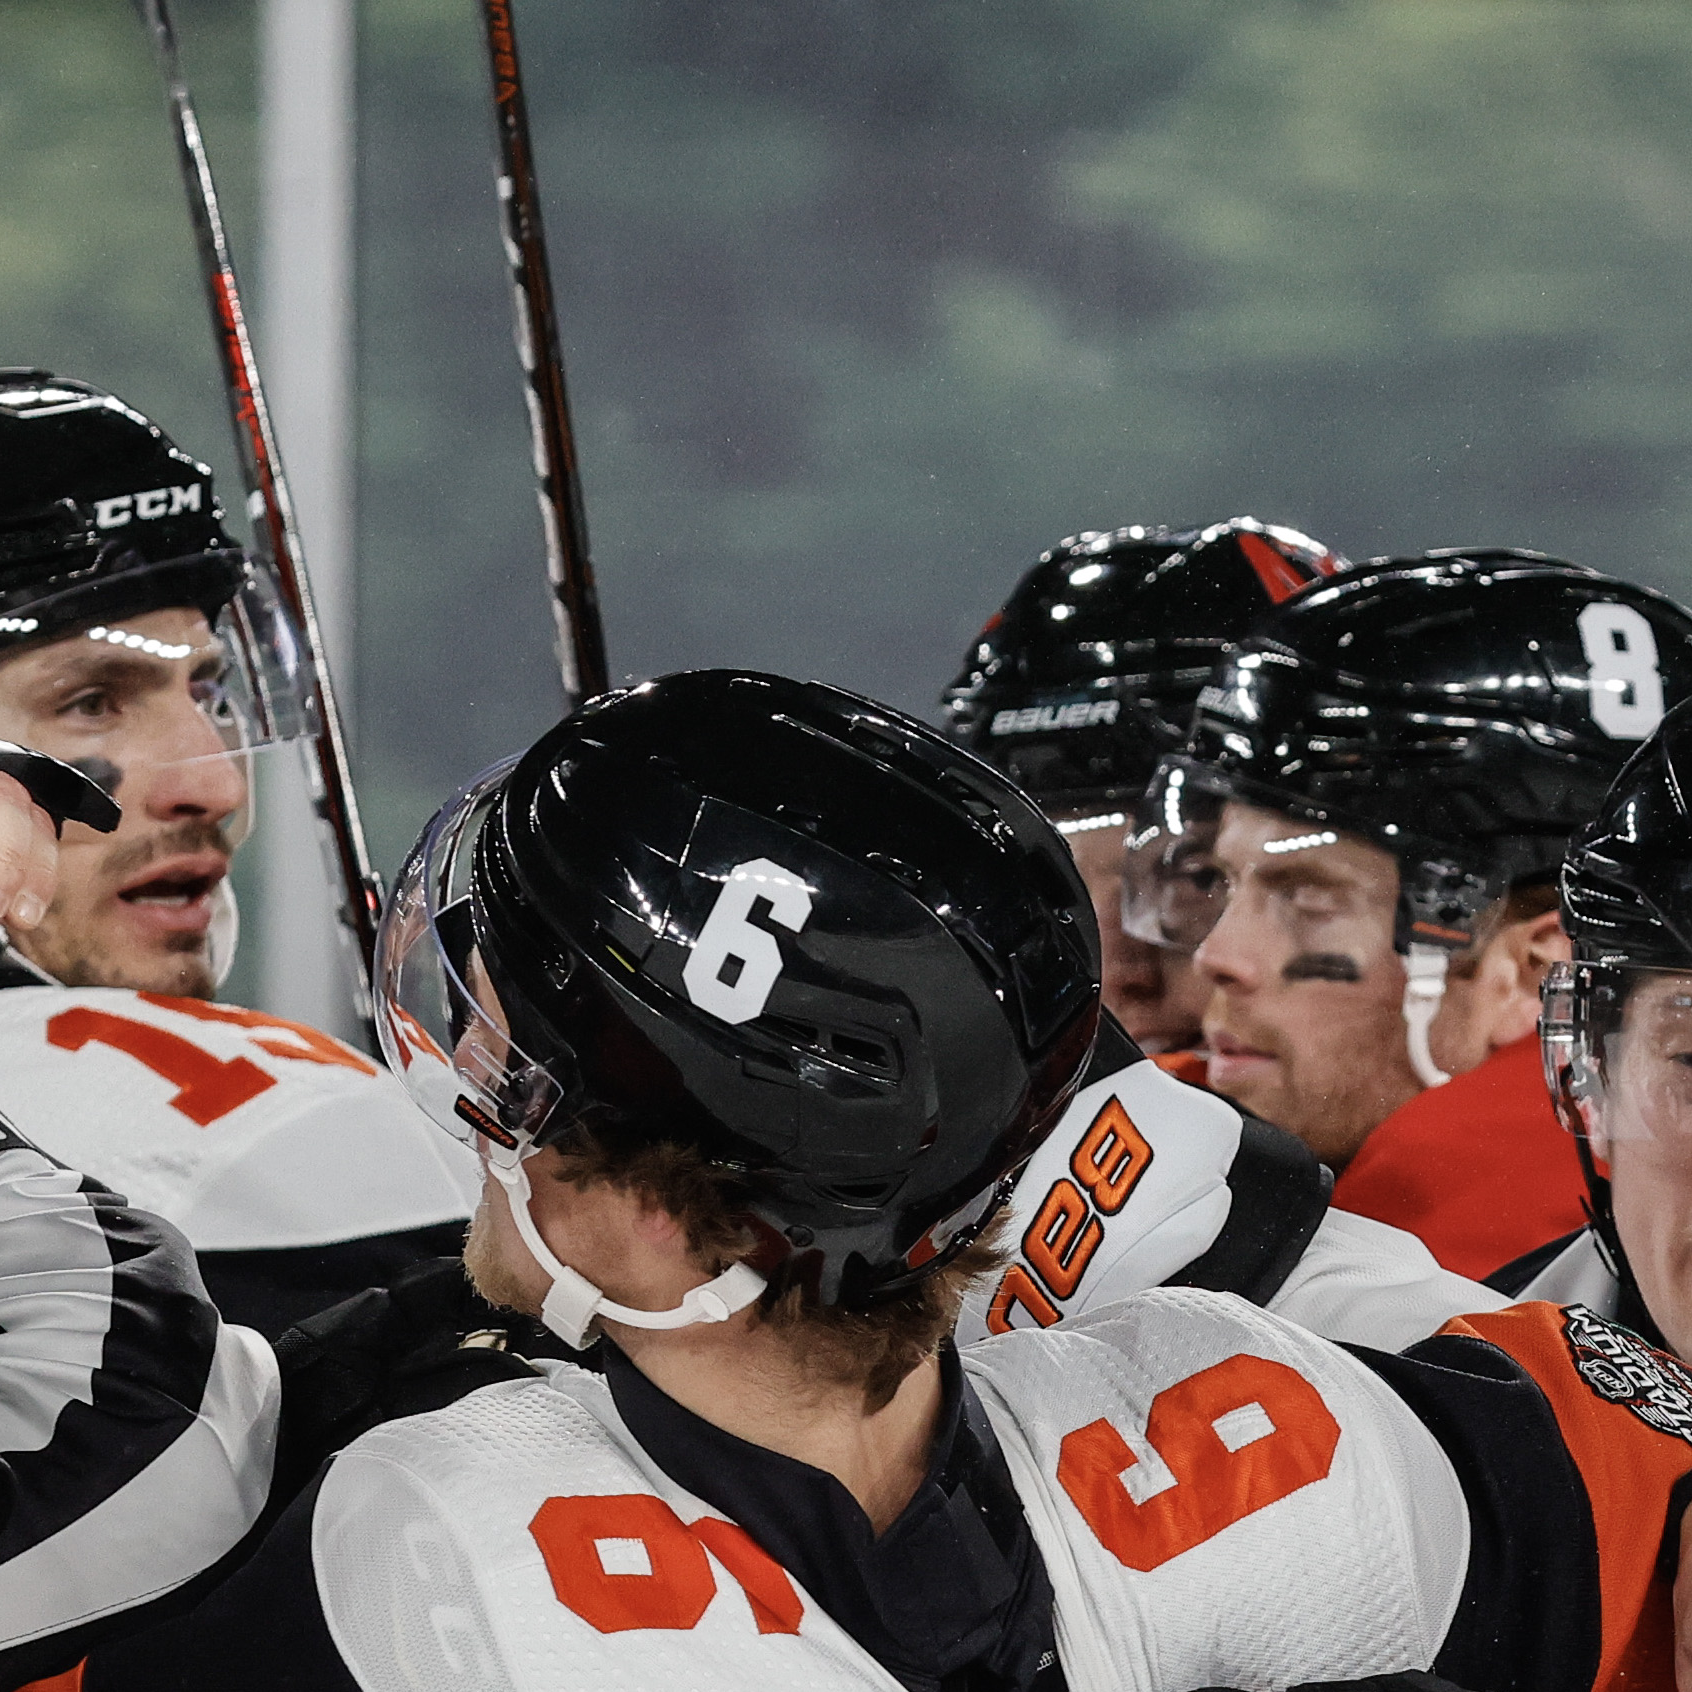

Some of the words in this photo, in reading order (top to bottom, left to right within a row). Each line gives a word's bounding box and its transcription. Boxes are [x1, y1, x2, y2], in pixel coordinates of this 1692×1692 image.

[93, 483, 202, 529] CCM
[990, 699, 1121, 735] BAUER
[1576, 602, 1664, 740] 8
[682, 857, 813, 1026] 6
[1057, 1353, 1342, 1573] 6
